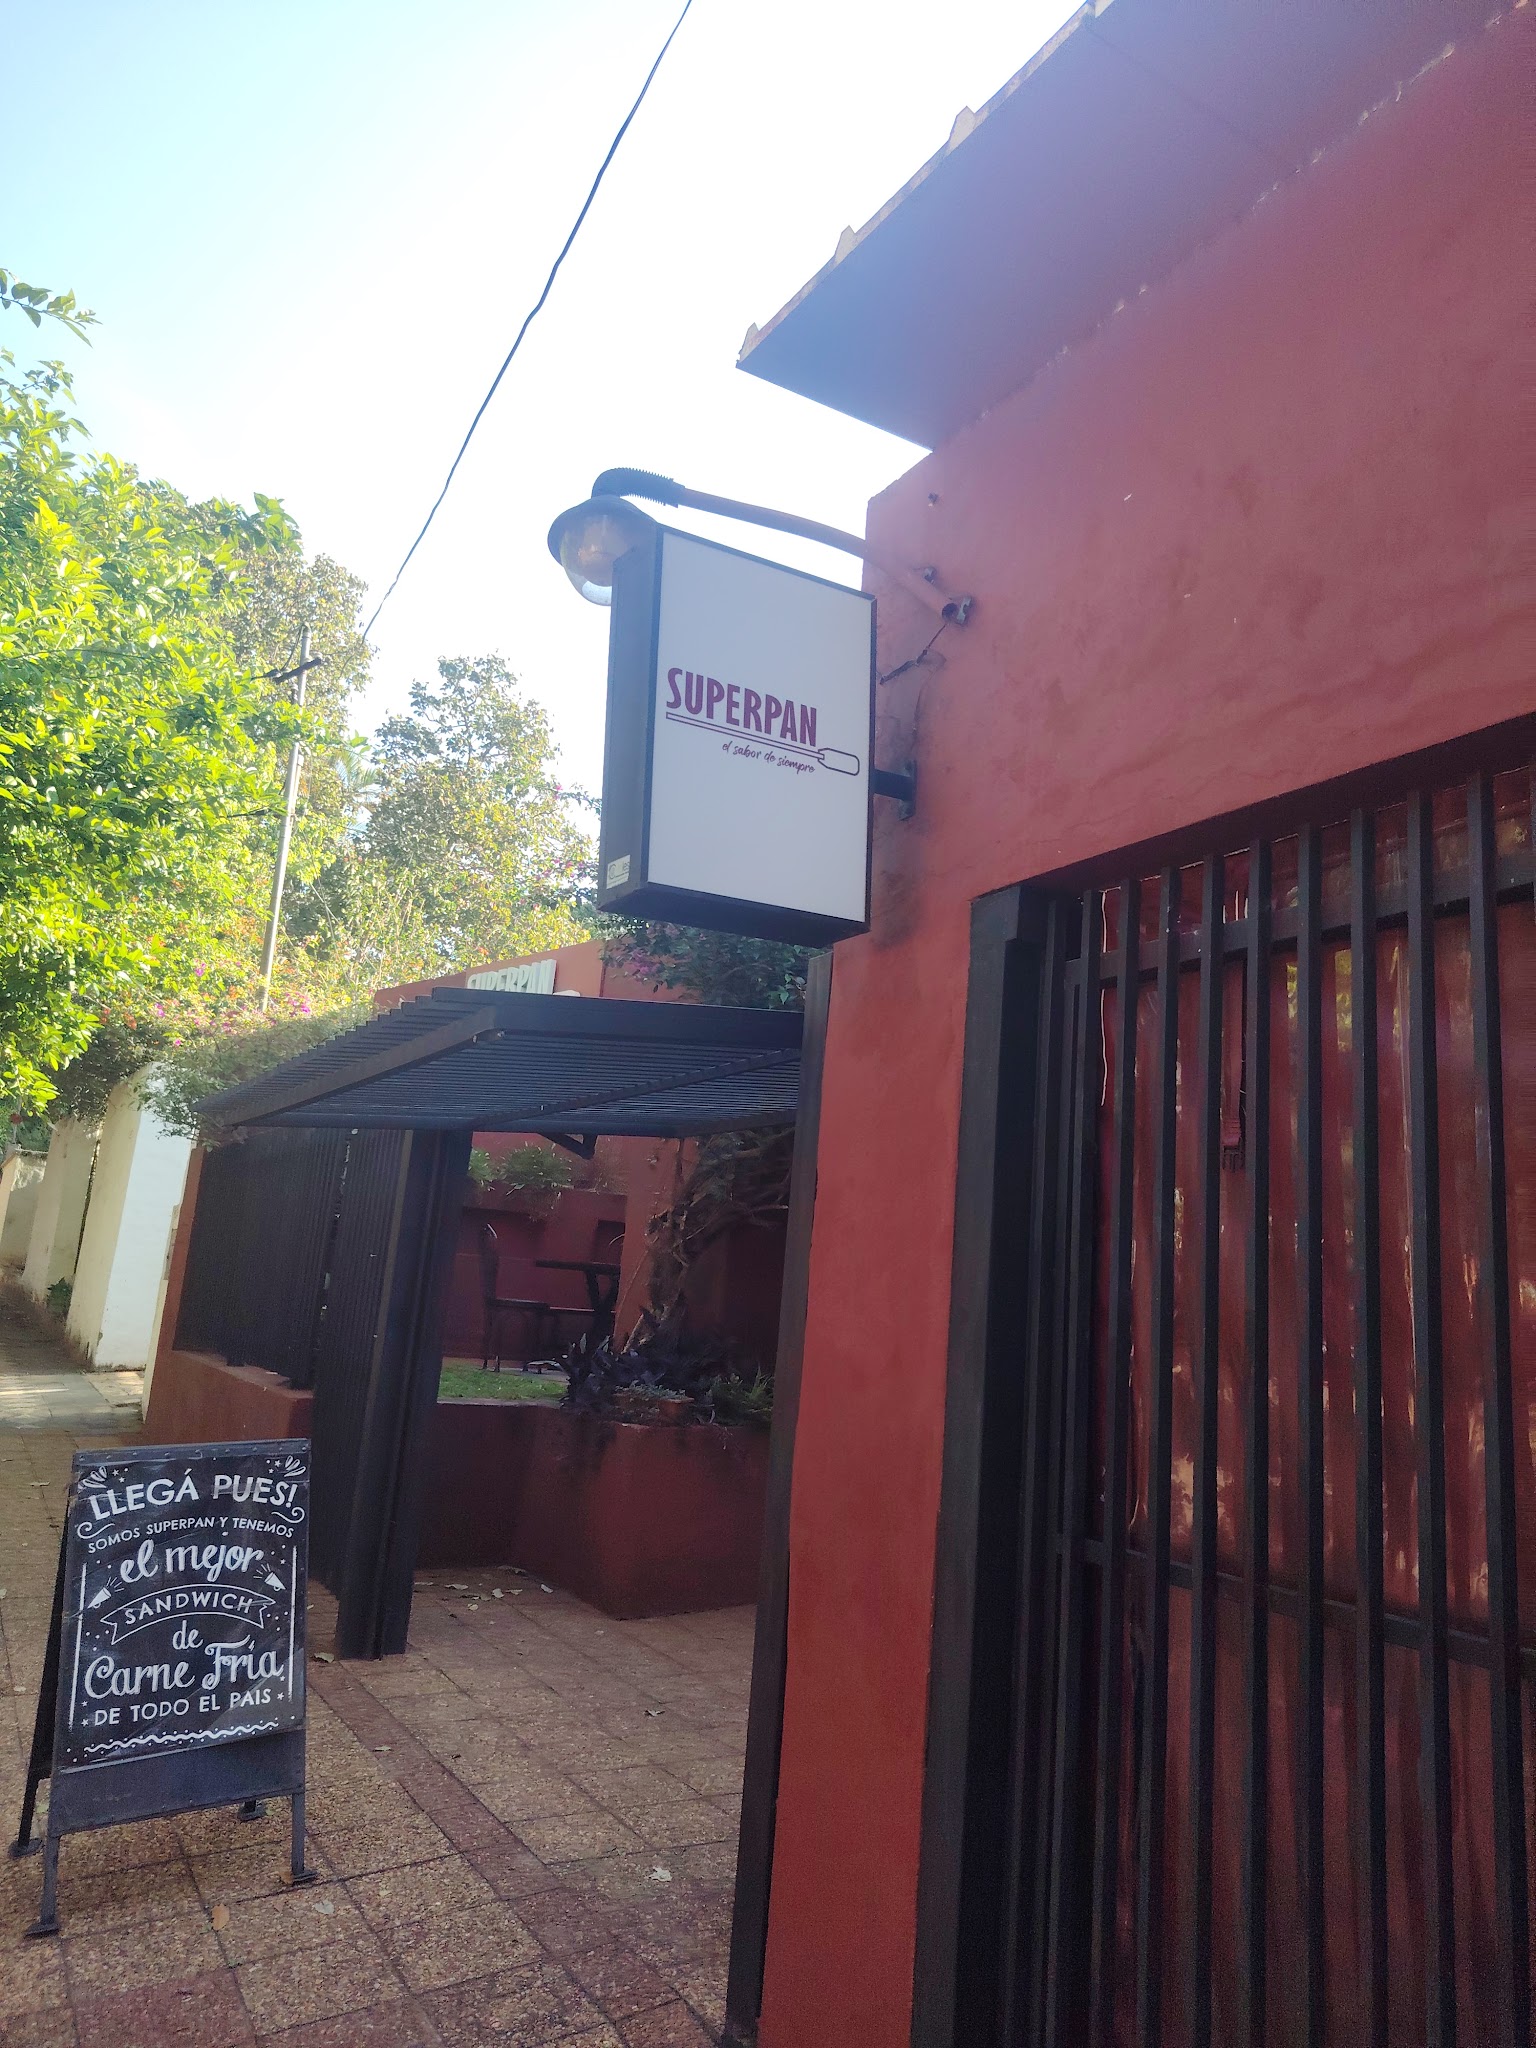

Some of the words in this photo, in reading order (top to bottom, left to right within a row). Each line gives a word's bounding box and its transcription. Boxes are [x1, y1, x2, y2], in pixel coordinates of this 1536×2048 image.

[666, 667, 817, 747] SUPERPAN
[721, 740, 733, 754] el
[733, 745, 761, 759] sabor
[764, 750, 776, 764] de
[777, 755, 816, 775] siempre
[89, 1468, 200, 1521] LLEGÁ
[212, 1474, 298, 1508] PUES!
[88, 1527, 140, 1554] SOMOS
[146, 1516, 215, 1535] SUPERPAN
[219, 1516, 229, 1528] Y
[232, 1517, 294, 1538] TENEMOS
[120, 1539, 159, 1583] el
[165, 1531, 265, 1582] mejor
[124, 1591, 254, 1625] SANDWICH
[172, 1620, 203, 1650] de
[84, 1655, 195, 1699] Carne
[202, 1634, 285, 1690] Fría
[94, 1707, 121, 1726] DE
[130, 1698, 190, 1722] TODO
[199, 1694, 221, 1712] EL
[229, 1688, 272, 1708] PAIS
